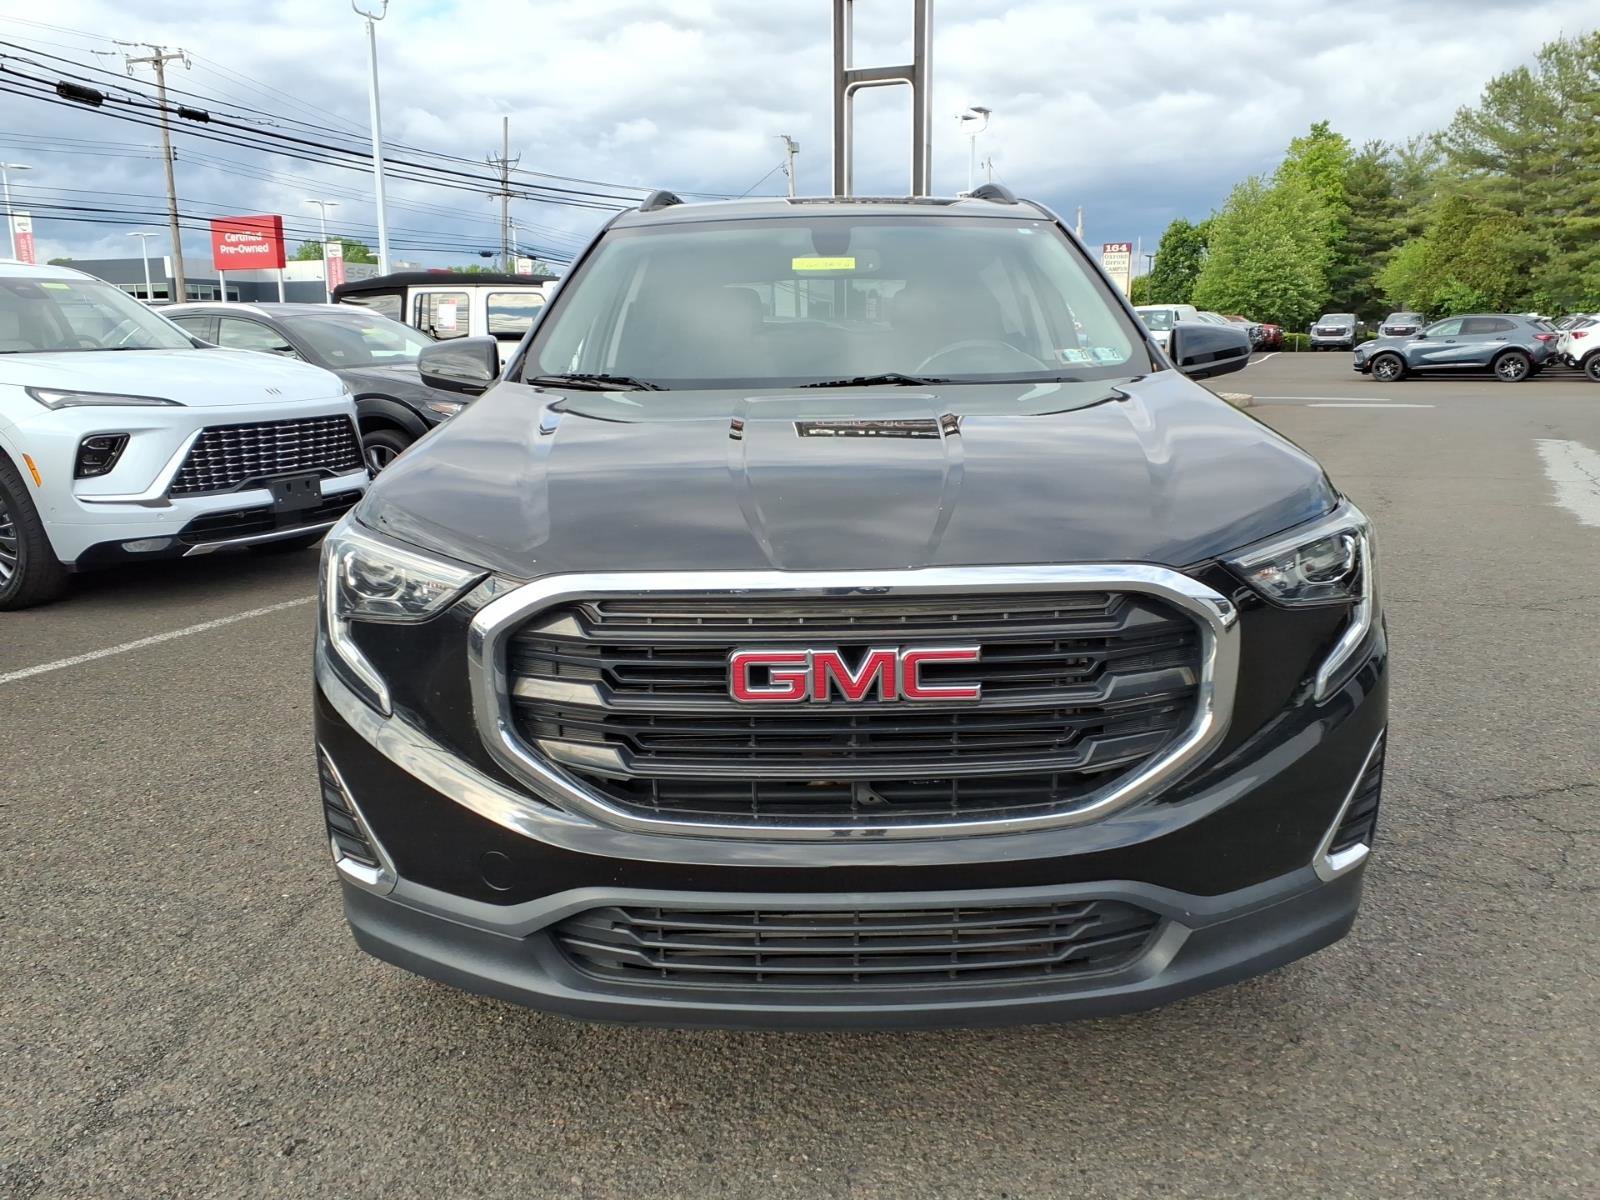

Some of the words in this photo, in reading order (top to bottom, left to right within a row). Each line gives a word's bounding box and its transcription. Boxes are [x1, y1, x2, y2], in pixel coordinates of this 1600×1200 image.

[224, 231, 263, 242] Certified
[220, 243, 269, 254] Pre-Owned
[1105, 243, 1128, 252] 164
[729, 645, 982, 703] GMC
